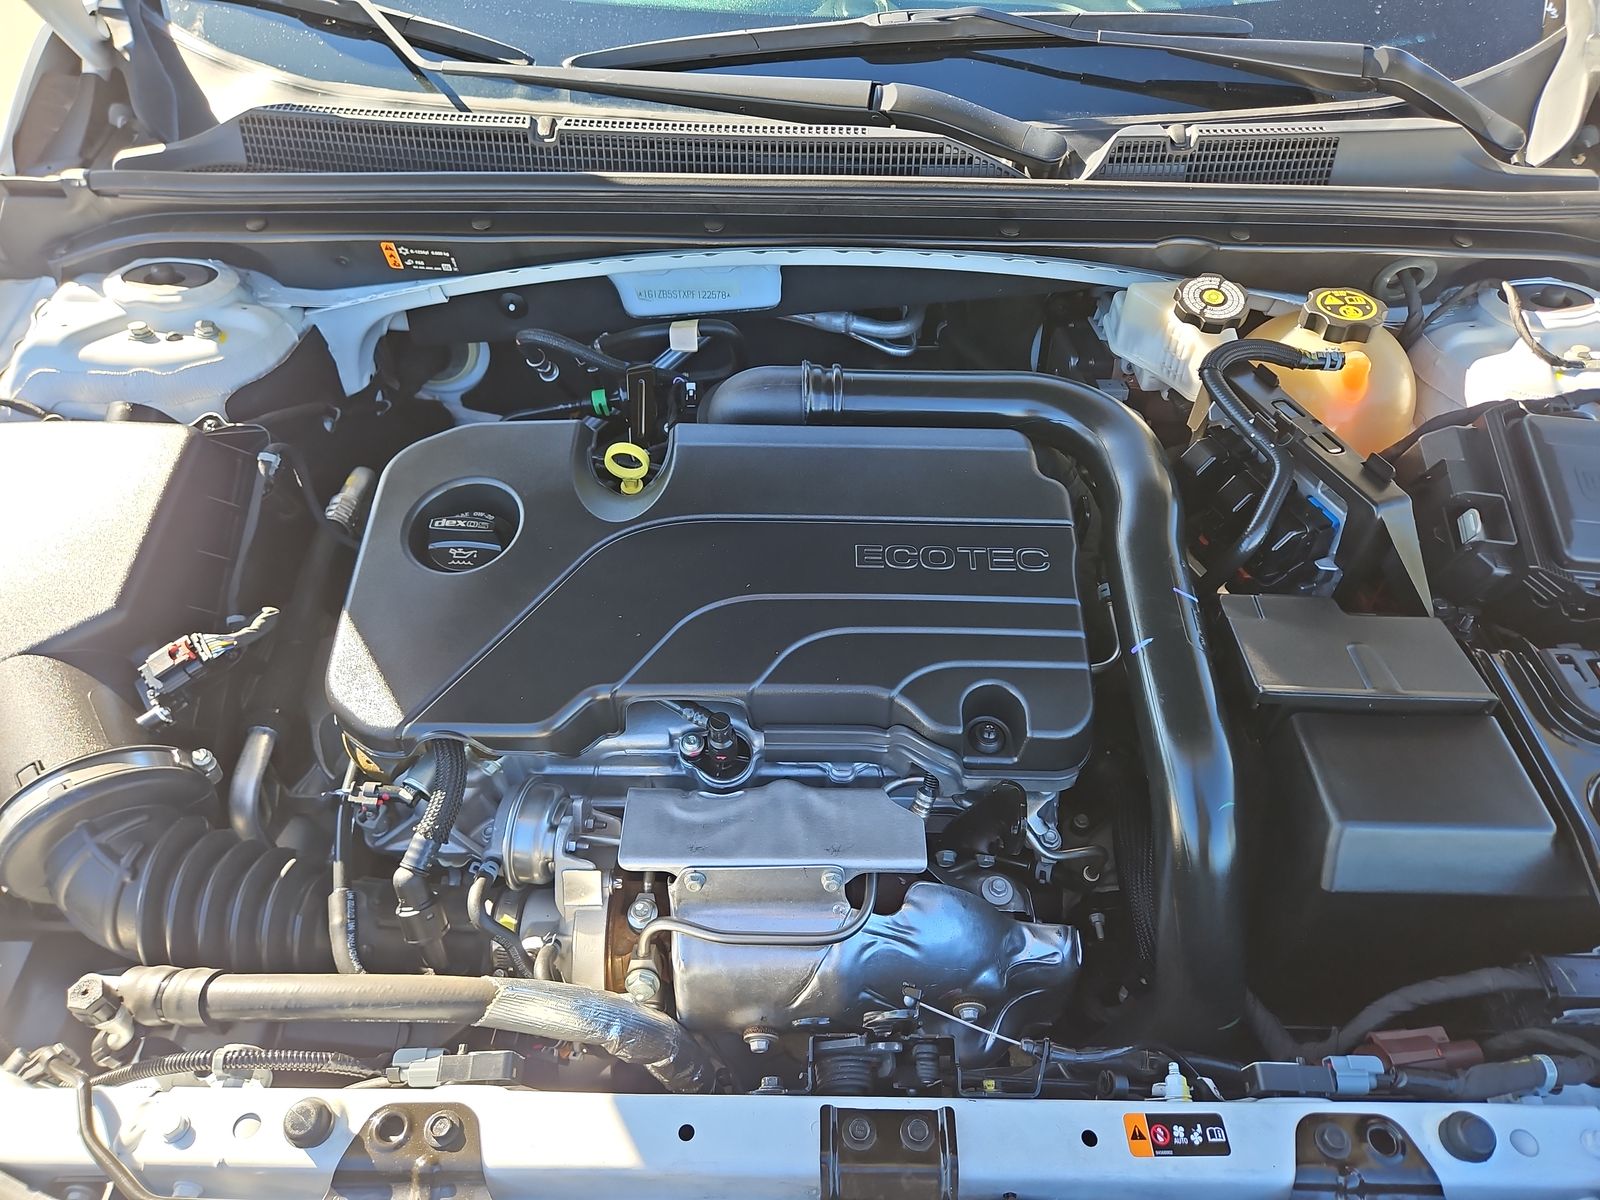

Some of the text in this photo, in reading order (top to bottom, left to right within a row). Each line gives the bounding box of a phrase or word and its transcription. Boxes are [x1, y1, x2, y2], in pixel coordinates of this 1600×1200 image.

[434, 518, 489, 529] dexos
[854, 544, 1051, 572] ECOTEC
[1174, 1137, 1189, 1145] AUTO
